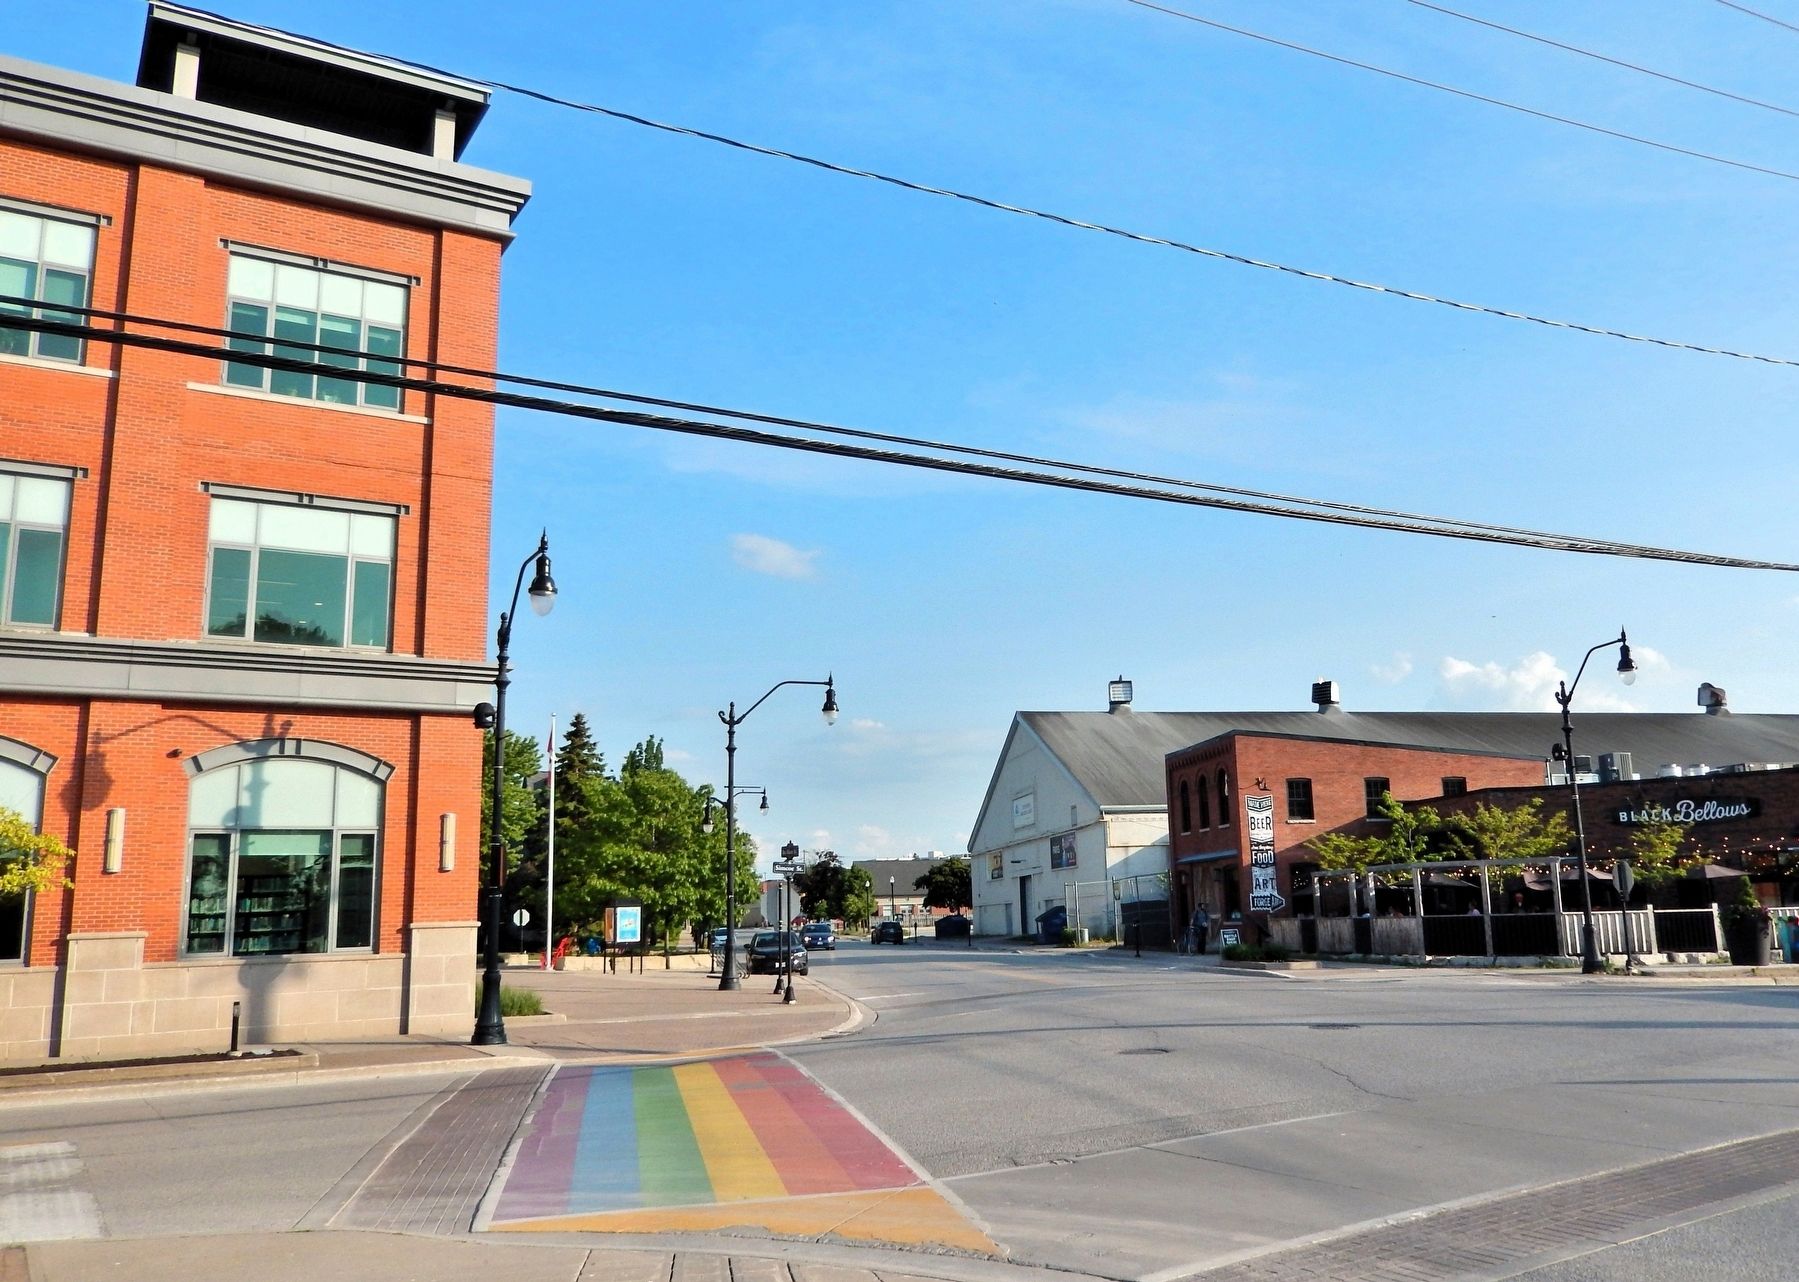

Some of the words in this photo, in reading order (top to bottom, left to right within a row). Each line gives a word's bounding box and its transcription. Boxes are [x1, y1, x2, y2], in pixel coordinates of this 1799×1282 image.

[1618, 808, 1672, 822] BLACK
[1674, 800, 1751, 822] Bellows
[1250, 816, 1272, 830] BEER
[1252, 851, 1274, 864] FOOD
[1254, 877, 1275, 890] ART
